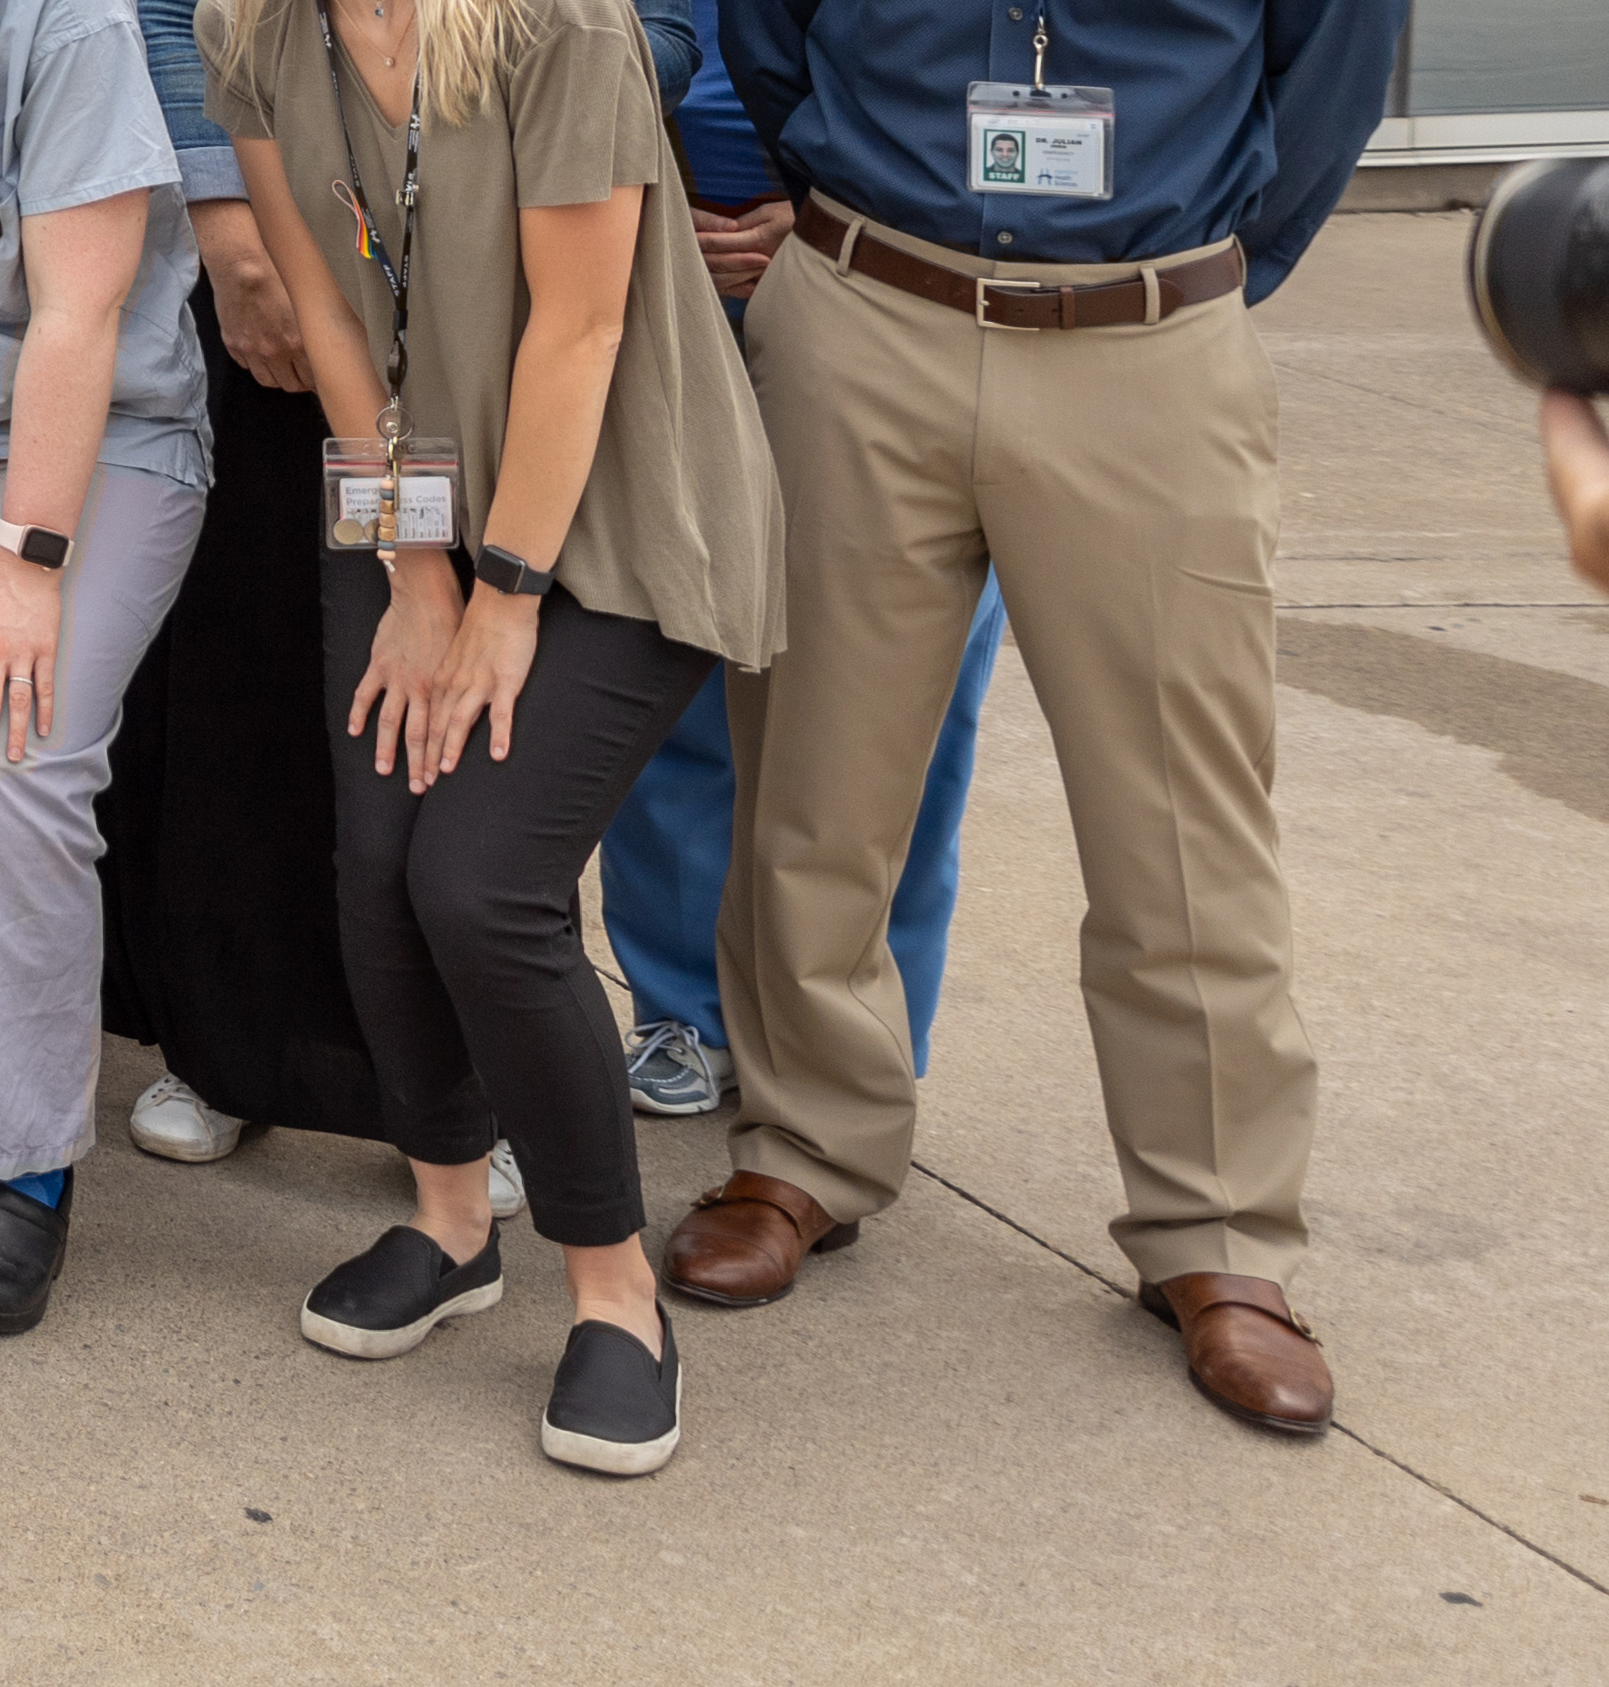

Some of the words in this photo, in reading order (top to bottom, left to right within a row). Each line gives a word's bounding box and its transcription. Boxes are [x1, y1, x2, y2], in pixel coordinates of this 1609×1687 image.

[988, 172, 1020, 181] STAFF
[383, 264, 400, 297] STAFF
[415, 495, 447, 503] Codes
